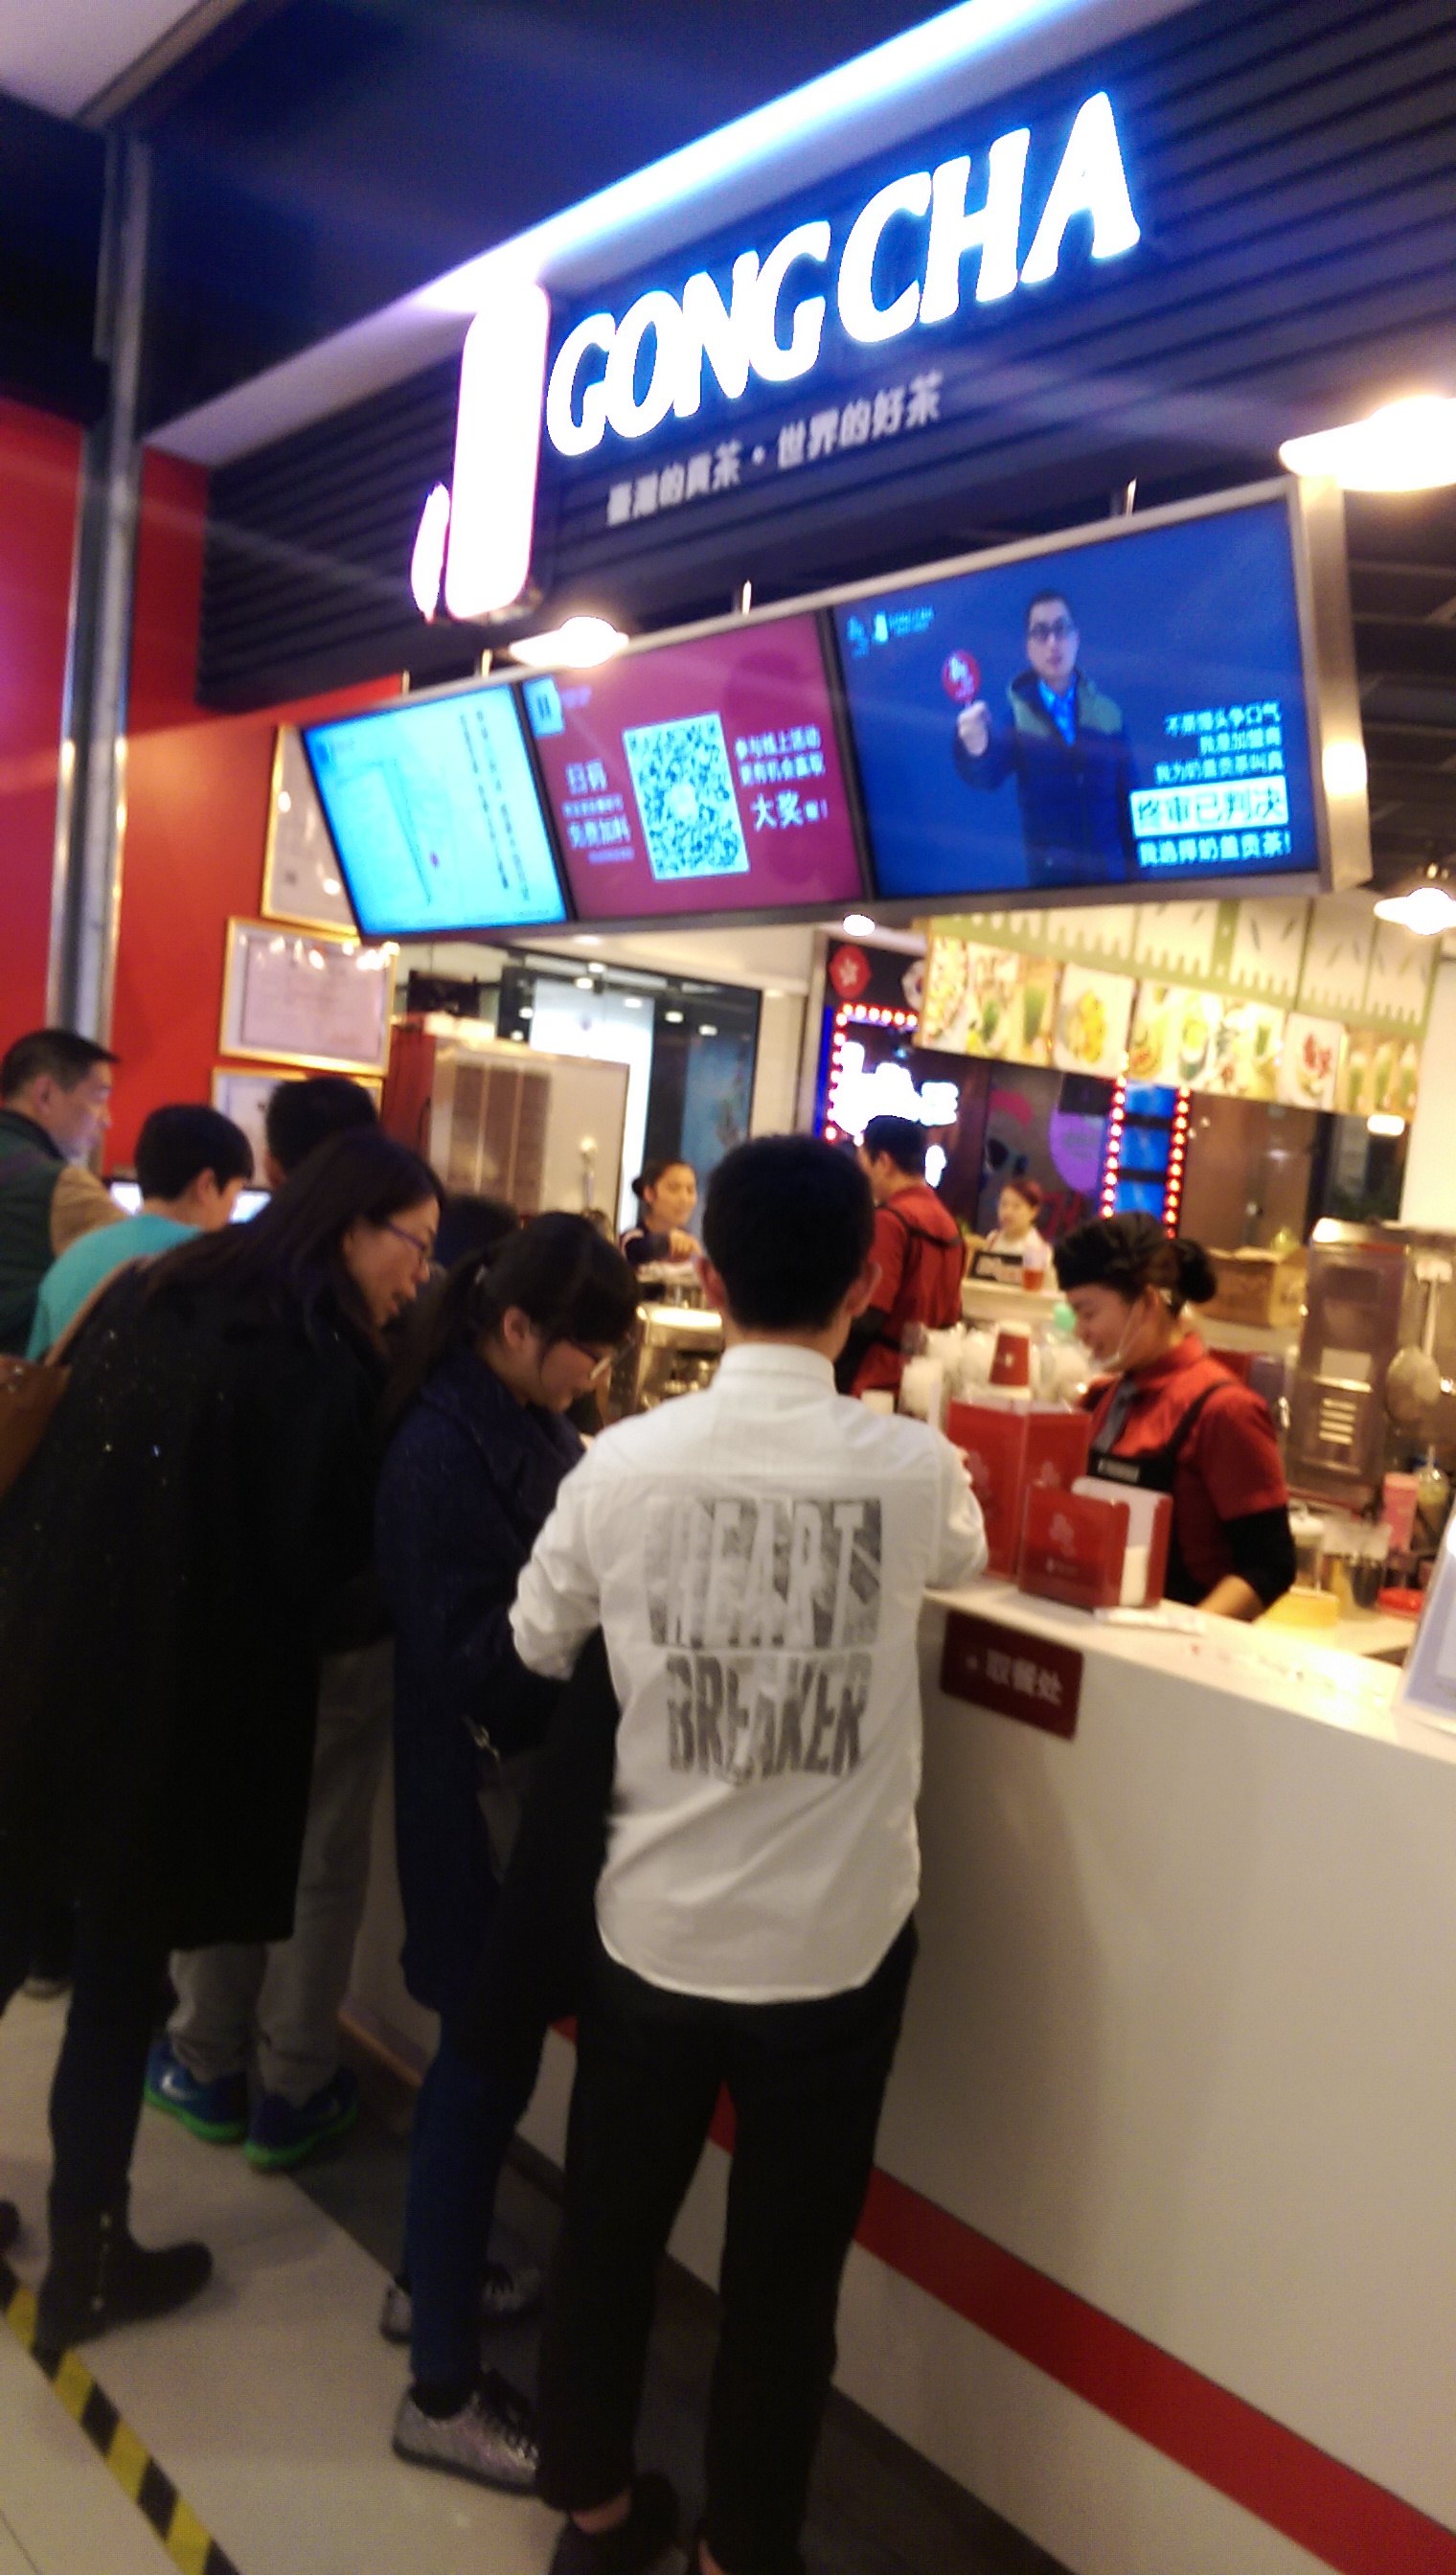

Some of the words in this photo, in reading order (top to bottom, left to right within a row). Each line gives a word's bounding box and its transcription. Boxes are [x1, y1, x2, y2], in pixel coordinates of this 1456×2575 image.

[547, 219, 831, 456] GONG
[839, 91, 1141, 343] CHA
[667, 1650, 873, 1785] BREAKER
